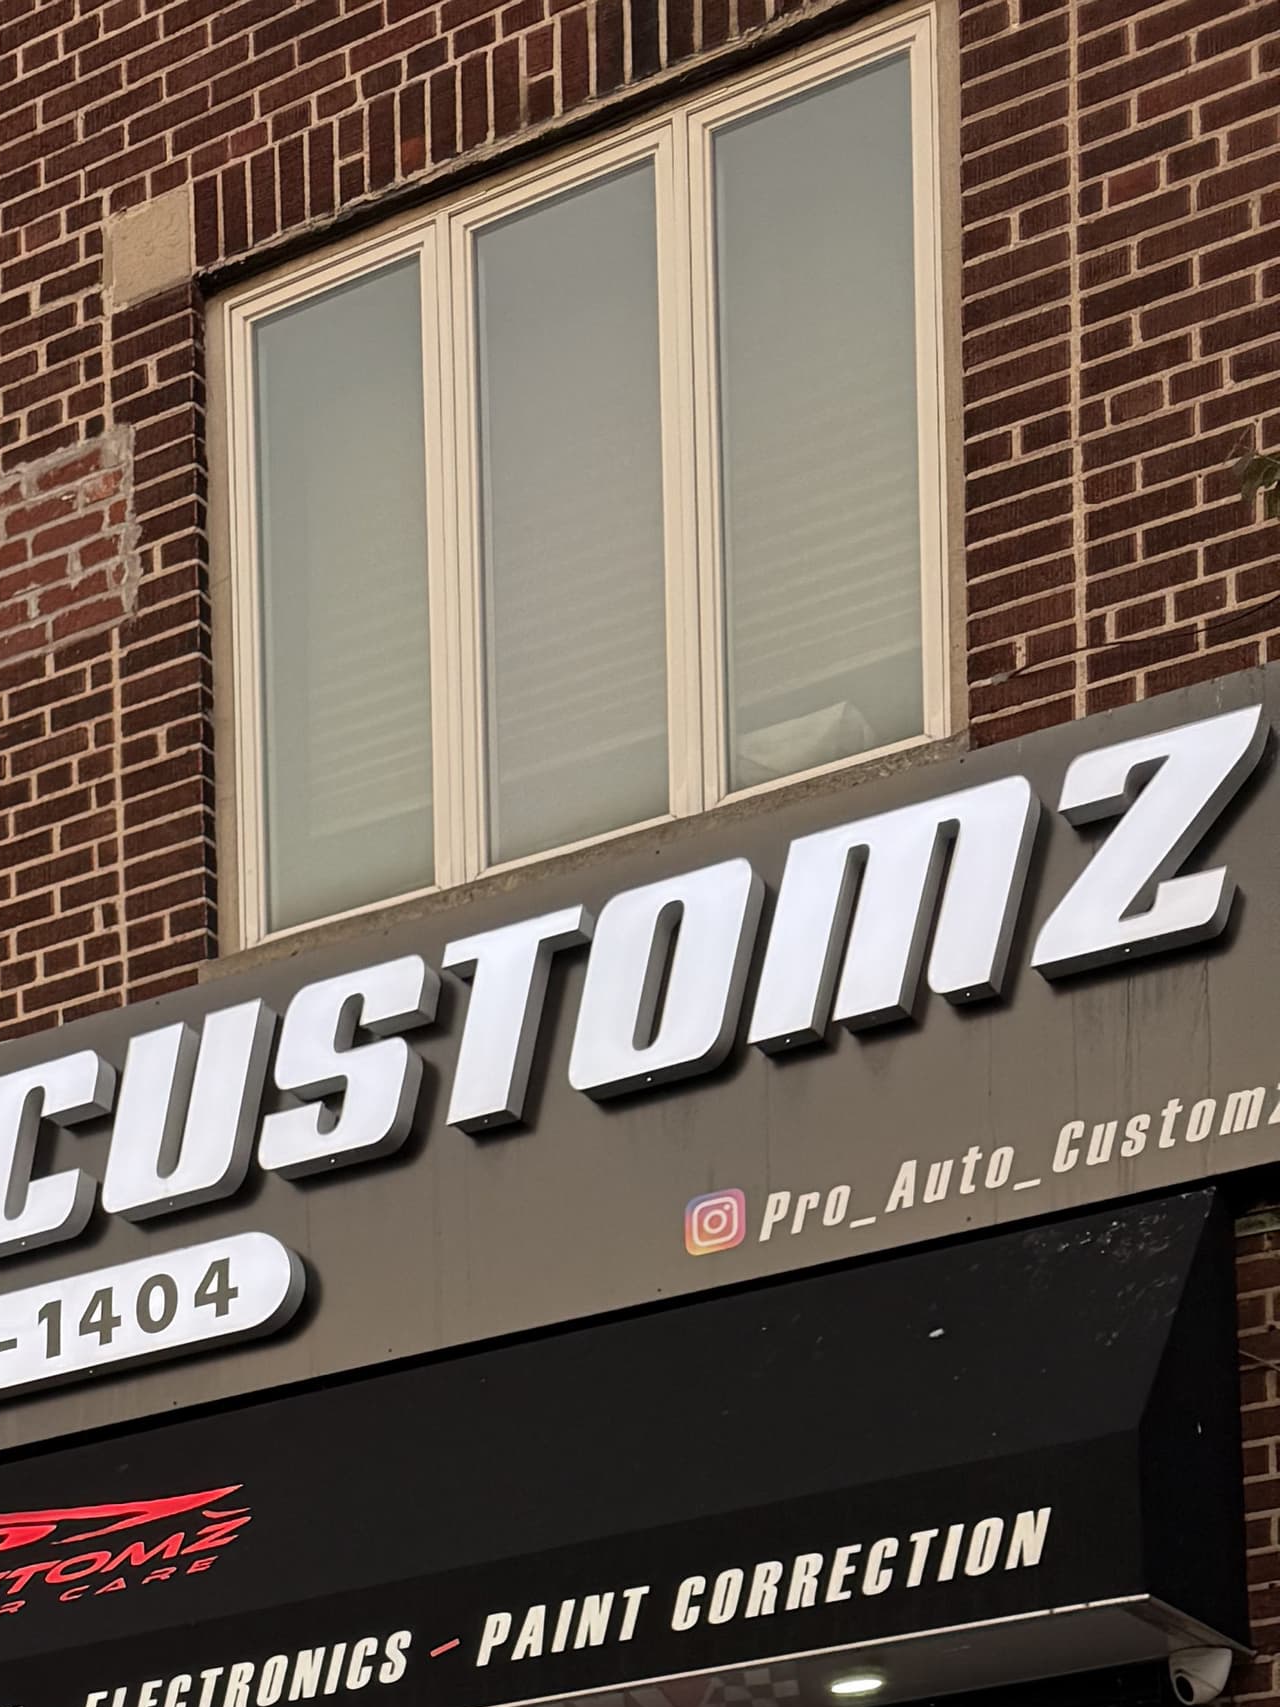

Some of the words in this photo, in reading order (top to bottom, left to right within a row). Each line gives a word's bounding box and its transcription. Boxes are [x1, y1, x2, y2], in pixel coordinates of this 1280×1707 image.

[57, 1556, 220, 1604] CARE
[475, 1586, 653, 1668] PAINT
[670, 1507, 1051, 1634] CORRECTION
